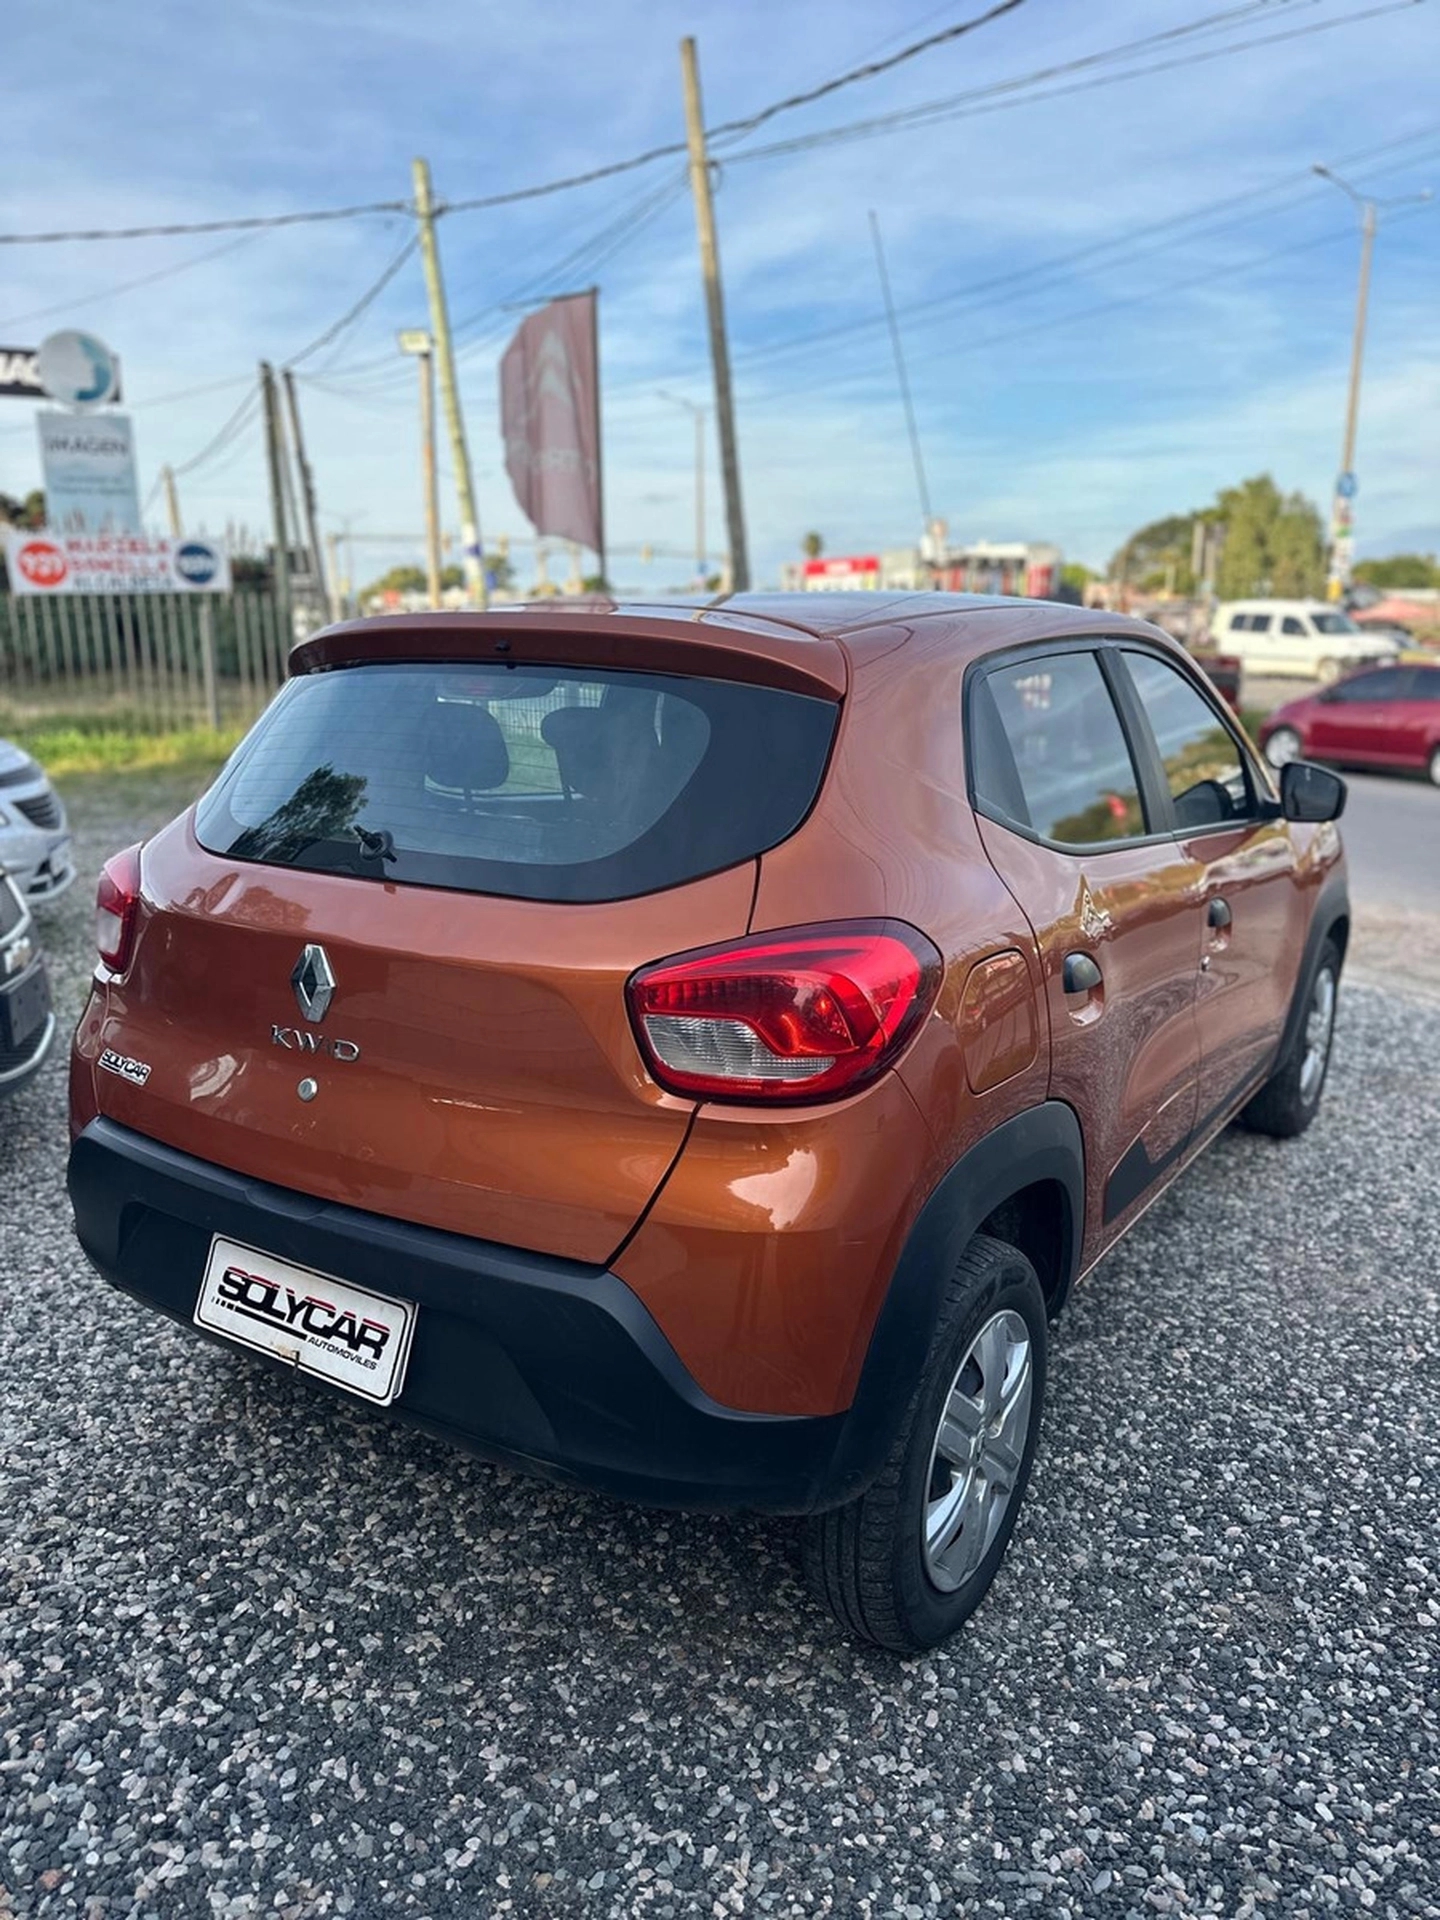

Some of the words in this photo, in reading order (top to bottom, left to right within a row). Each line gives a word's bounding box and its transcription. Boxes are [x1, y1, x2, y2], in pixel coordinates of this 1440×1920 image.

[46, 434, 129, 456] IMAGEN
[271, 1025, 360, 1060] KWID
[102, 1050, 149, 1079] SOLYCAR
[218, 1266, 391, 1361] SOLYCAR
[307, 1336, 378, 1370] AUTOMOVILES
